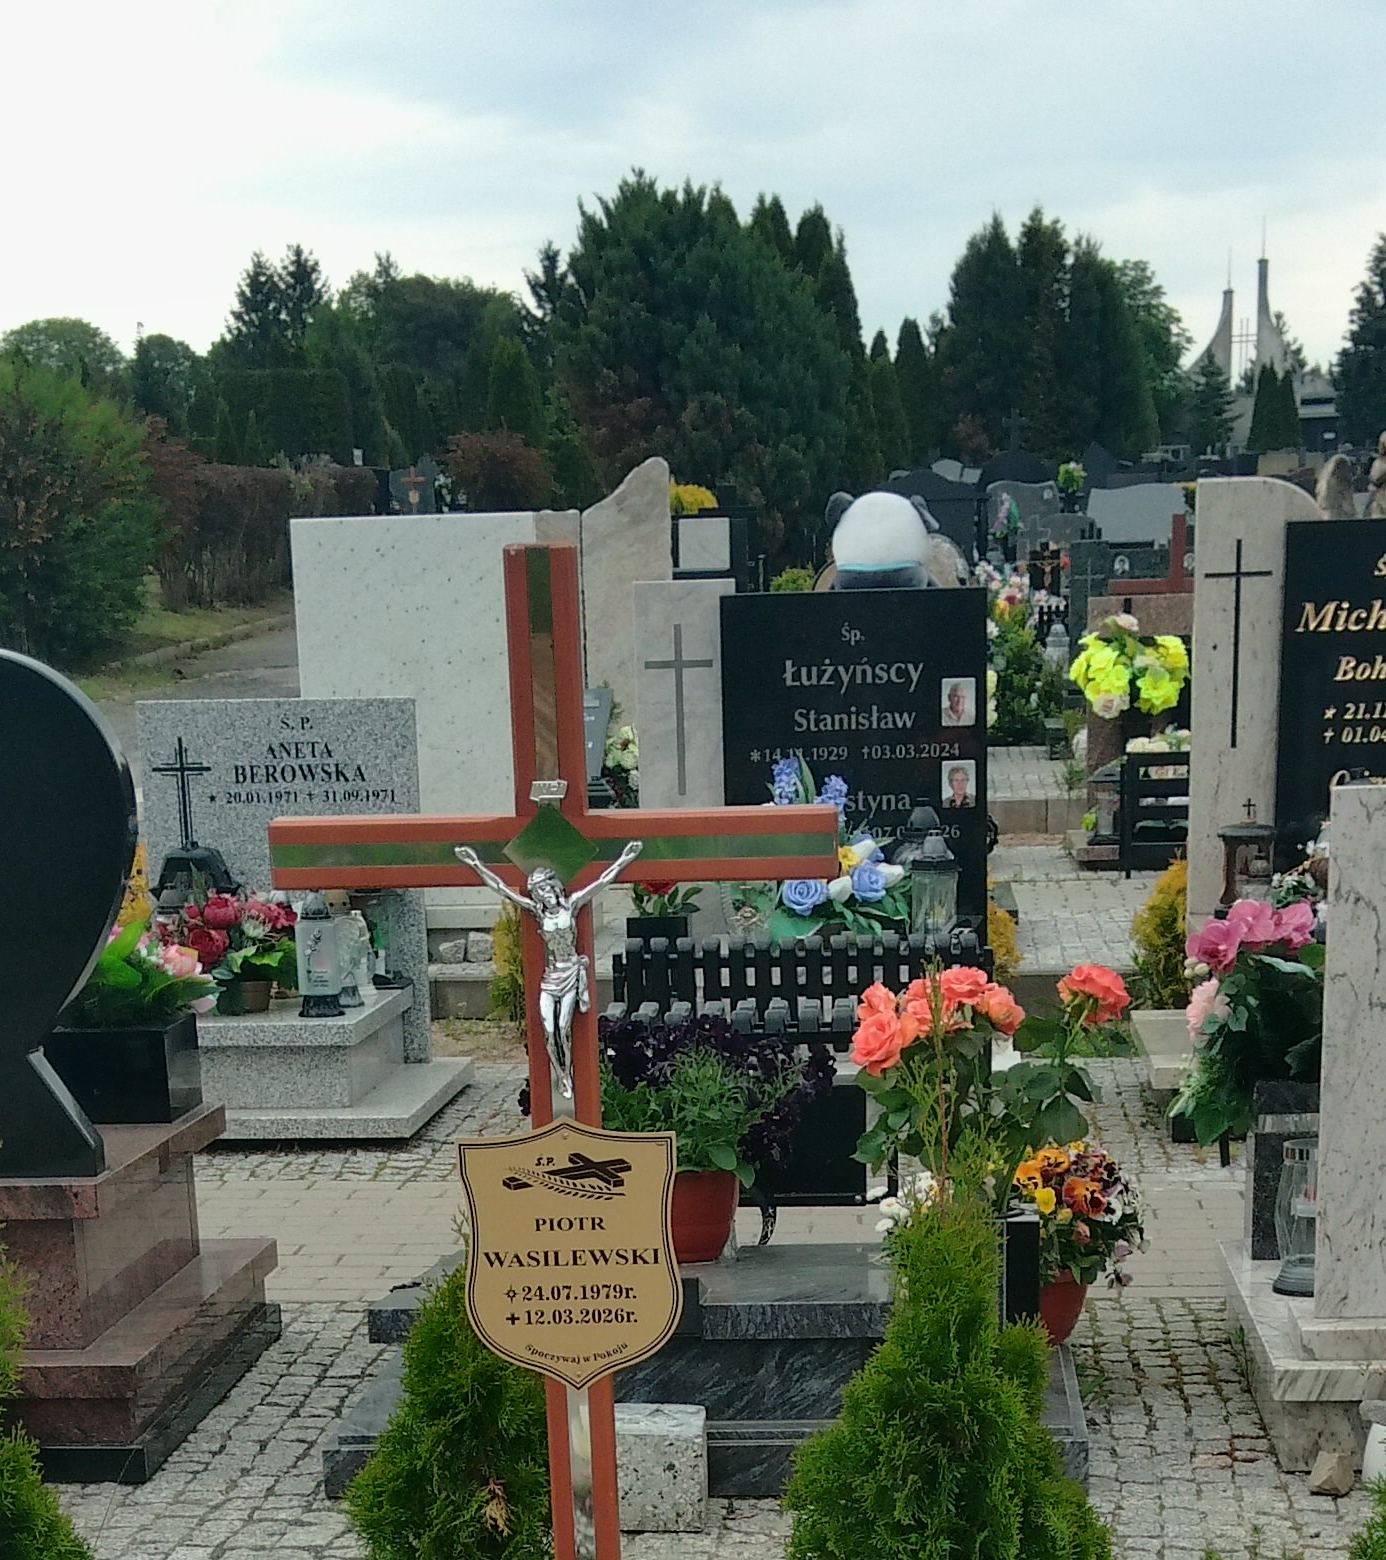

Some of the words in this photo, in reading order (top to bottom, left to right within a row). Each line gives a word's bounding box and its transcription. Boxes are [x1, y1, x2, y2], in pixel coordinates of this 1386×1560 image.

[782, 656, 924, 695] Łużyńscy
[793, 704, 917, 733] Stanisław
[264, 741, 334, 760] ANETA
[233, 762, 367, 785] BEROWSKA
[845, 789, 912, 819] styna
[534, 1216, 607, 1233] PIOTR
[482, 1247, 662, 1269] WASILEWSKI
[522, 1283, 638, 1302] 24.07.1979r.
[524, 1307, 639, 1326] 12.03.2026r.
[524, 1342, 581, 1365] Spoczywaj
[593, 1340, 629, 1361] Pokoju
